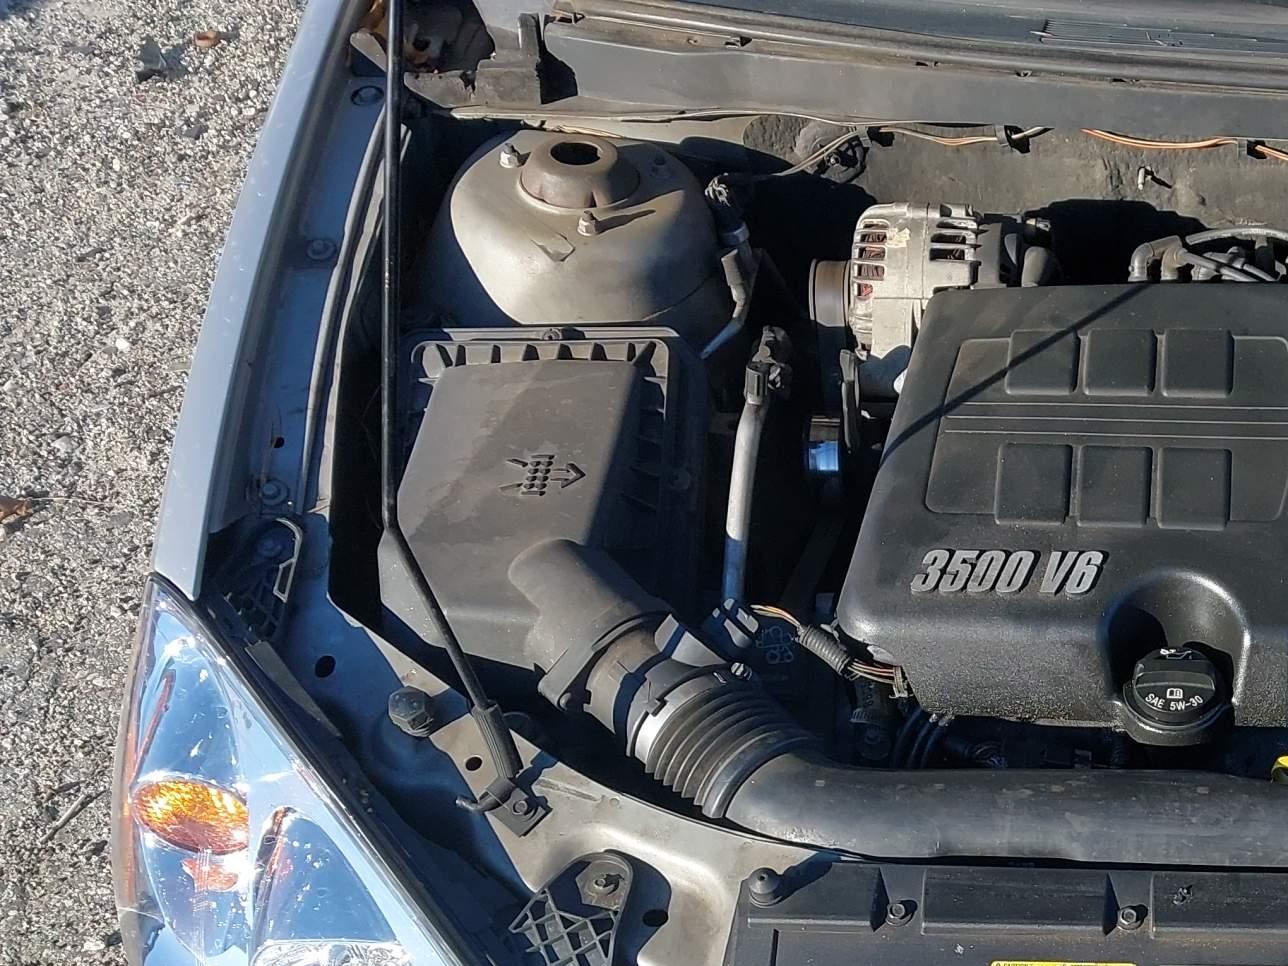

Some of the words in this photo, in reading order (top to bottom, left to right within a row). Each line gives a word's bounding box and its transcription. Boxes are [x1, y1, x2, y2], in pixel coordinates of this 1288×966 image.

[910, 549, 1036, 594] 3500
[1040, 550, 1106, 595] V6
[1145, 693, 1165, 709] SAE
[1170, 695, 1203, 710] 5W-30
